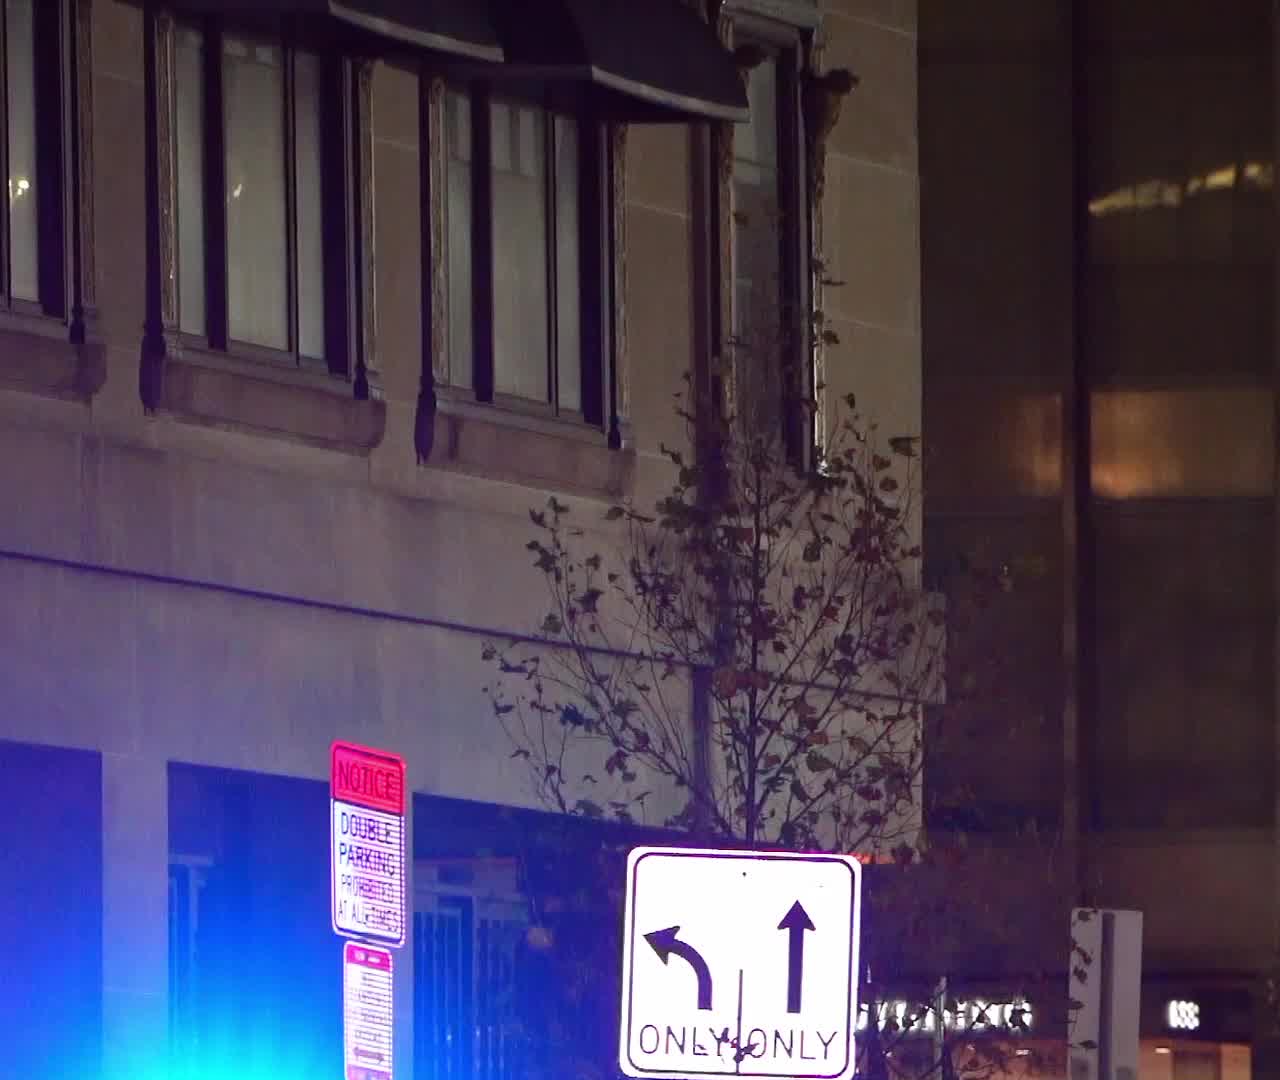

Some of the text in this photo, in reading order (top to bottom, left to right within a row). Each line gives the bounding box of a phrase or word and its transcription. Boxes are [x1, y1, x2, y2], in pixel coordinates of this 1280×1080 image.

[338, 760, 396, 800] NOTICE
[341, 812, 393, 845] DOUBLE
[339, 843, 395, 876] PARKING
[639, 1024, 838, 1060] ONLY ONLY
